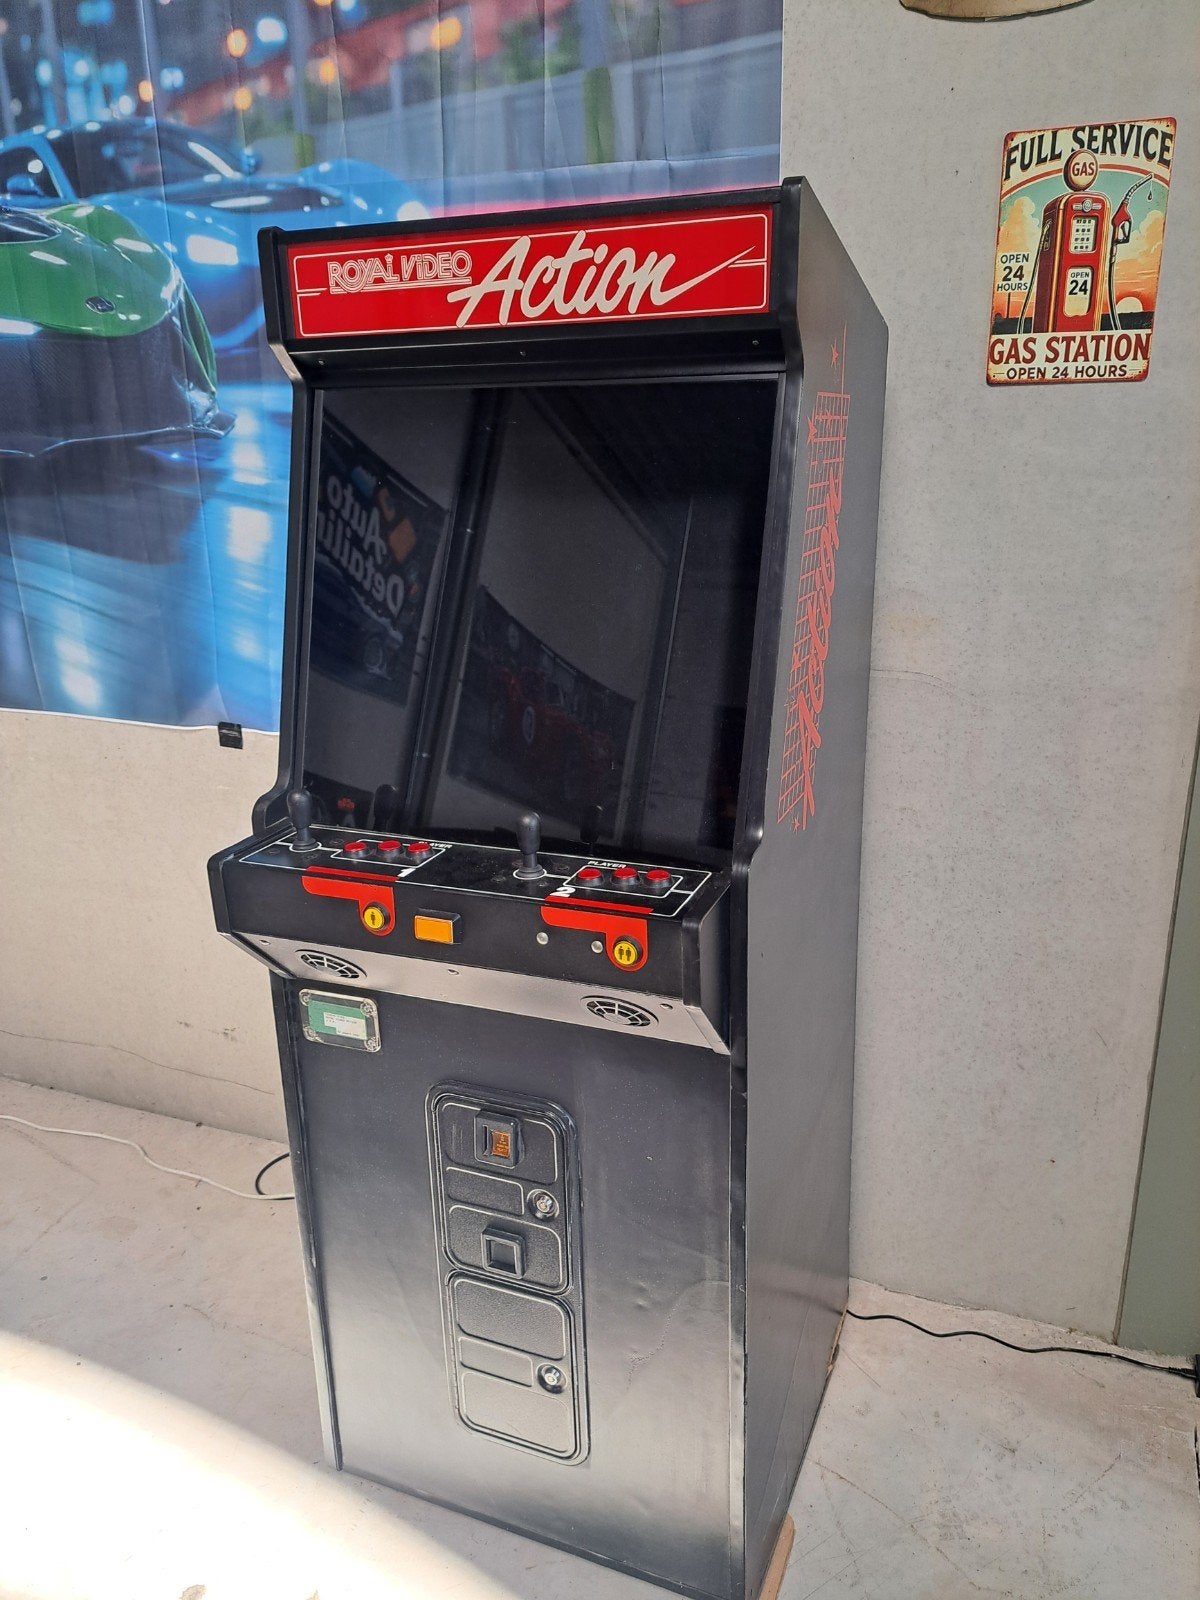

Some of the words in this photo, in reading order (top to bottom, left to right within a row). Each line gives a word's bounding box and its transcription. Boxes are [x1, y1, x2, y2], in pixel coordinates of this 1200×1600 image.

[1004, 130, 1063, 181] FULL
[1071, 123, 1174, 169] SERVICE
[1071, 161, 1095, 177] GAS
[1000, 253, 1029, 264] OPEN
[327, 253, 400, 293] ROYAL
[447, 230, 756, 328] Action
[1002, 265, 1024, 282] 24
[1070, 271, 1089, 279] OPEN
[996, 282, 1028, 292] HOURS
[1068, 279, 1088, 295] 24
[989, 336, 1037, 365] GAS
[1045, 333, 1152, 364] STATION
[1006, 367, 1046, 380] OPEN
[1052, 366, 1069, 379] 24
[1074, 364, 1127, 379] HOURS
[397, 867, 416, 878] 1
[587, 860, 627, 869] PLAYER
[549, 886, 576, 898] 2
